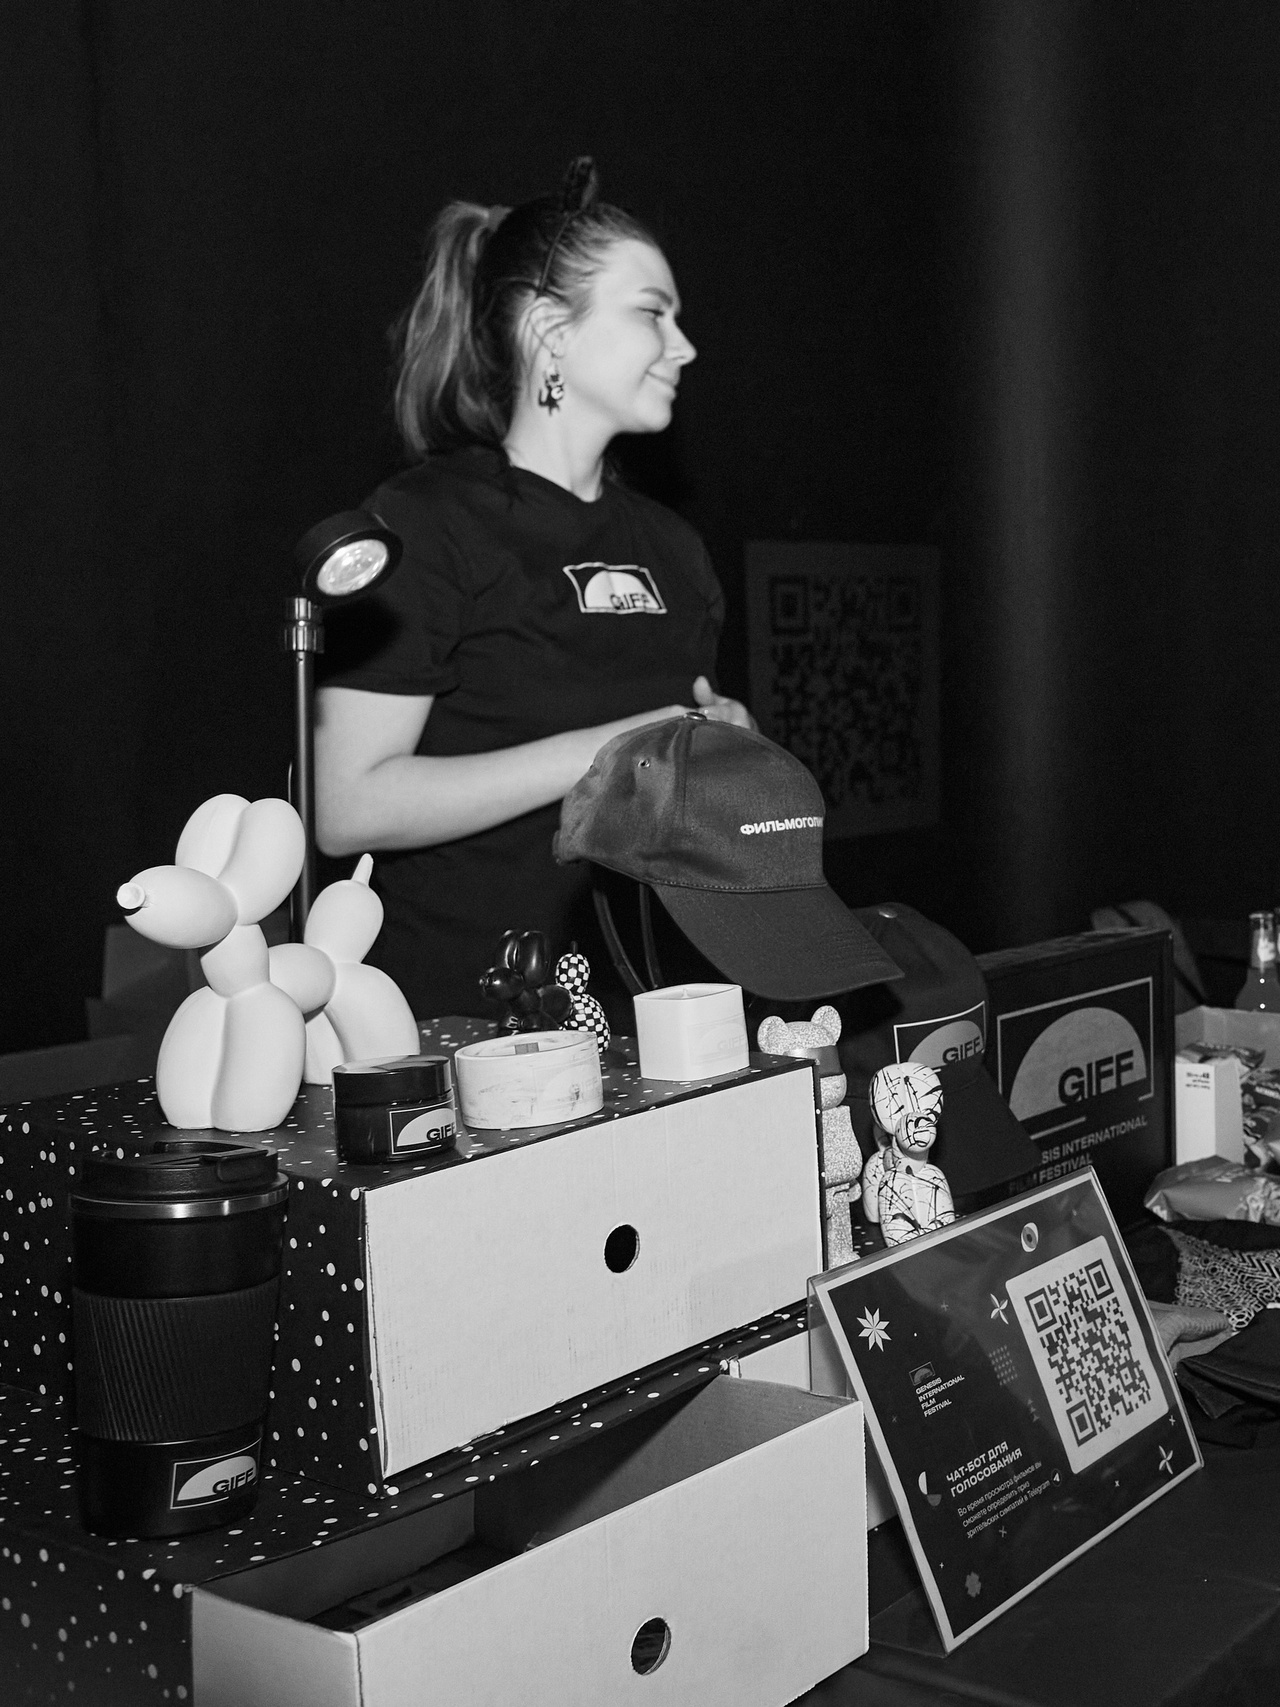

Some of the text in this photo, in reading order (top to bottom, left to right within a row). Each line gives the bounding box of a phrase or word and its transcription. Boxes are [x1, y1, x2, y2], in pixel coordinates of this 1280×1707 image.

[942, 1035, 981, 1065] GIFF
[1058, 1050, 1135, 1104] GIFF
[1062, 1115, 1149, 1157] INTERNATIONAL
[1039, 1152, 1093, 1184] FESTIVAL
[915, 1377, 942, 1395] GENESIS
[918, 1374, 965, 1403] INTERNATIONAL
[921, 1397, 936, 1410] FILM
[923, 1399, 952, 1418] FESTIVAL
[946, 1441, 1009, 1483] ЧАТ-БОТ ДЛЯ
[950, 1447, 1023, 1497] ГОЛОСОВАНИЯ
[212, 1467, 254, 1495] GIFF
[957, 1507, 967, 1517] Во
[966, 1496, 984, 1512] время
[984, 1478, 1014, 1501] просмотра
[962, 1508, 987, 1527] сможете
[987, 1489, 1018, 1511] определить
[966, 1514, 1000, 1539] зрительских
[999, 1495, 1024, 1517] симпатий
[1027, 1480, 1051, 1498] Telegram
